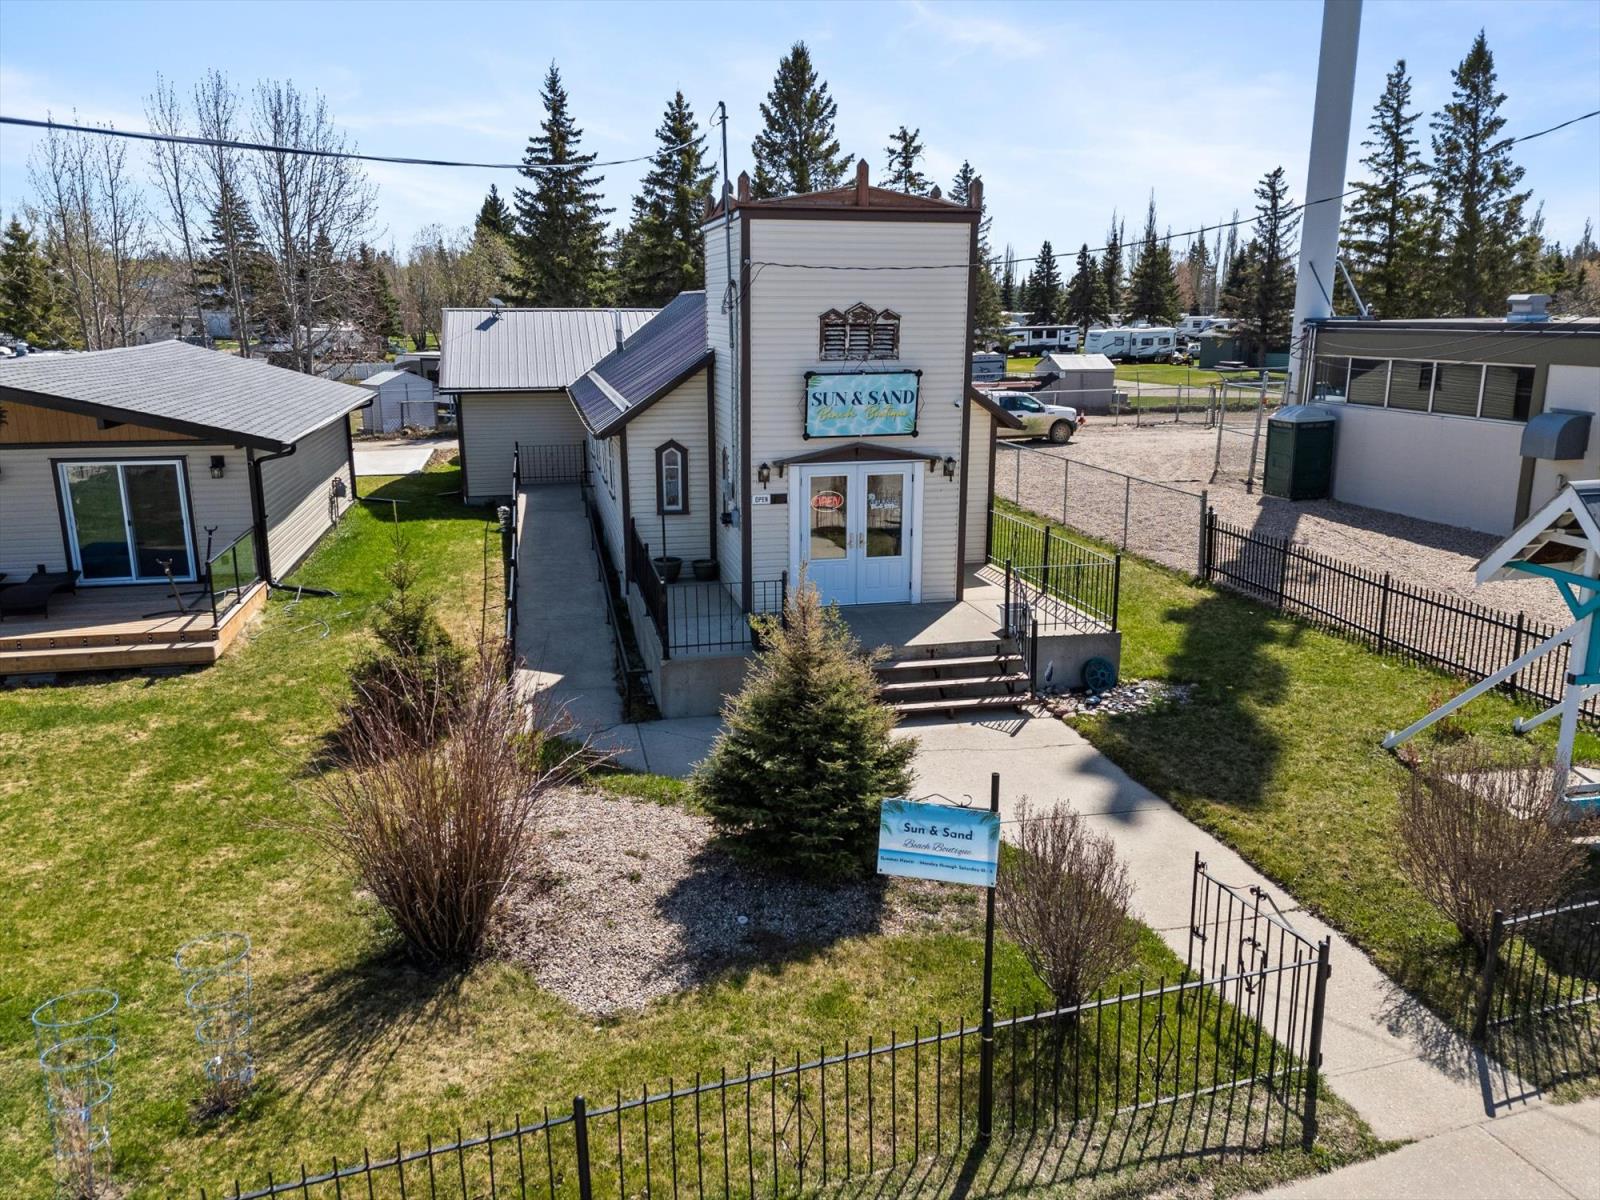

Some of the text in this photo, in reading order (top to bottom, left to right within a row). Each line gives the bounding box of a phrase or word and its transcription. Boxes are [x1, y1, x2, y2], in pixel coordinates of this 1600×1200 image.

[811, 389, 915, 406] SUN & SAND
[816, 406, 857, 422] Beach
[814, 495, 841, 507] OPEN
[904, 822, 973, 841] Sun & Sand
[902, 838, 972, 856] Beach Boutique
